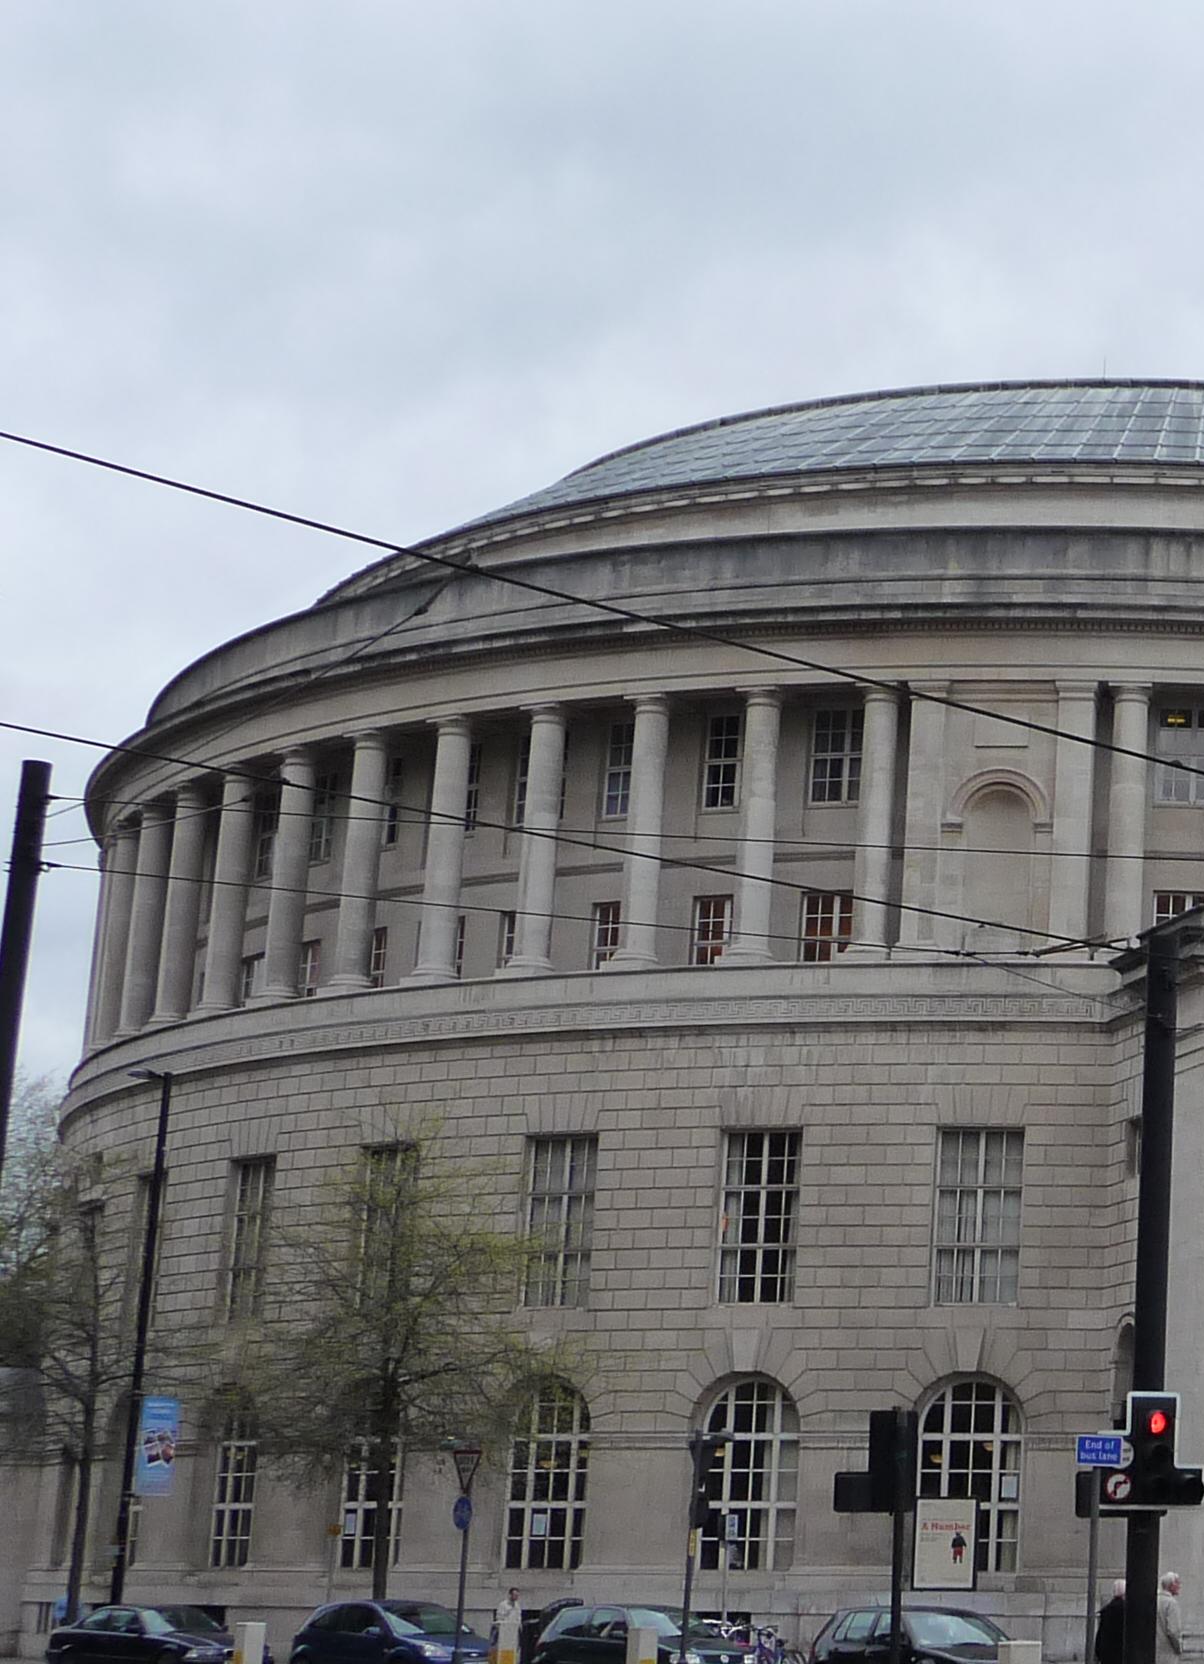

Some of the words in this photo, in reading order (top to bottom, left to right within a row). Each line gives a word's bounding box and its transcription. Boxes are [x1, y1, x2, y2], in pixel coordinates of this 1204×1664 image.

[1085, 1439, 1103, 1449] End
[1104, 1440, 1115, 1450] of
[1080, 1451, 1097, 1460] bus
[1098, 1451, 1118, 1461] lane
[931, 1522, 972, 1532] Number
